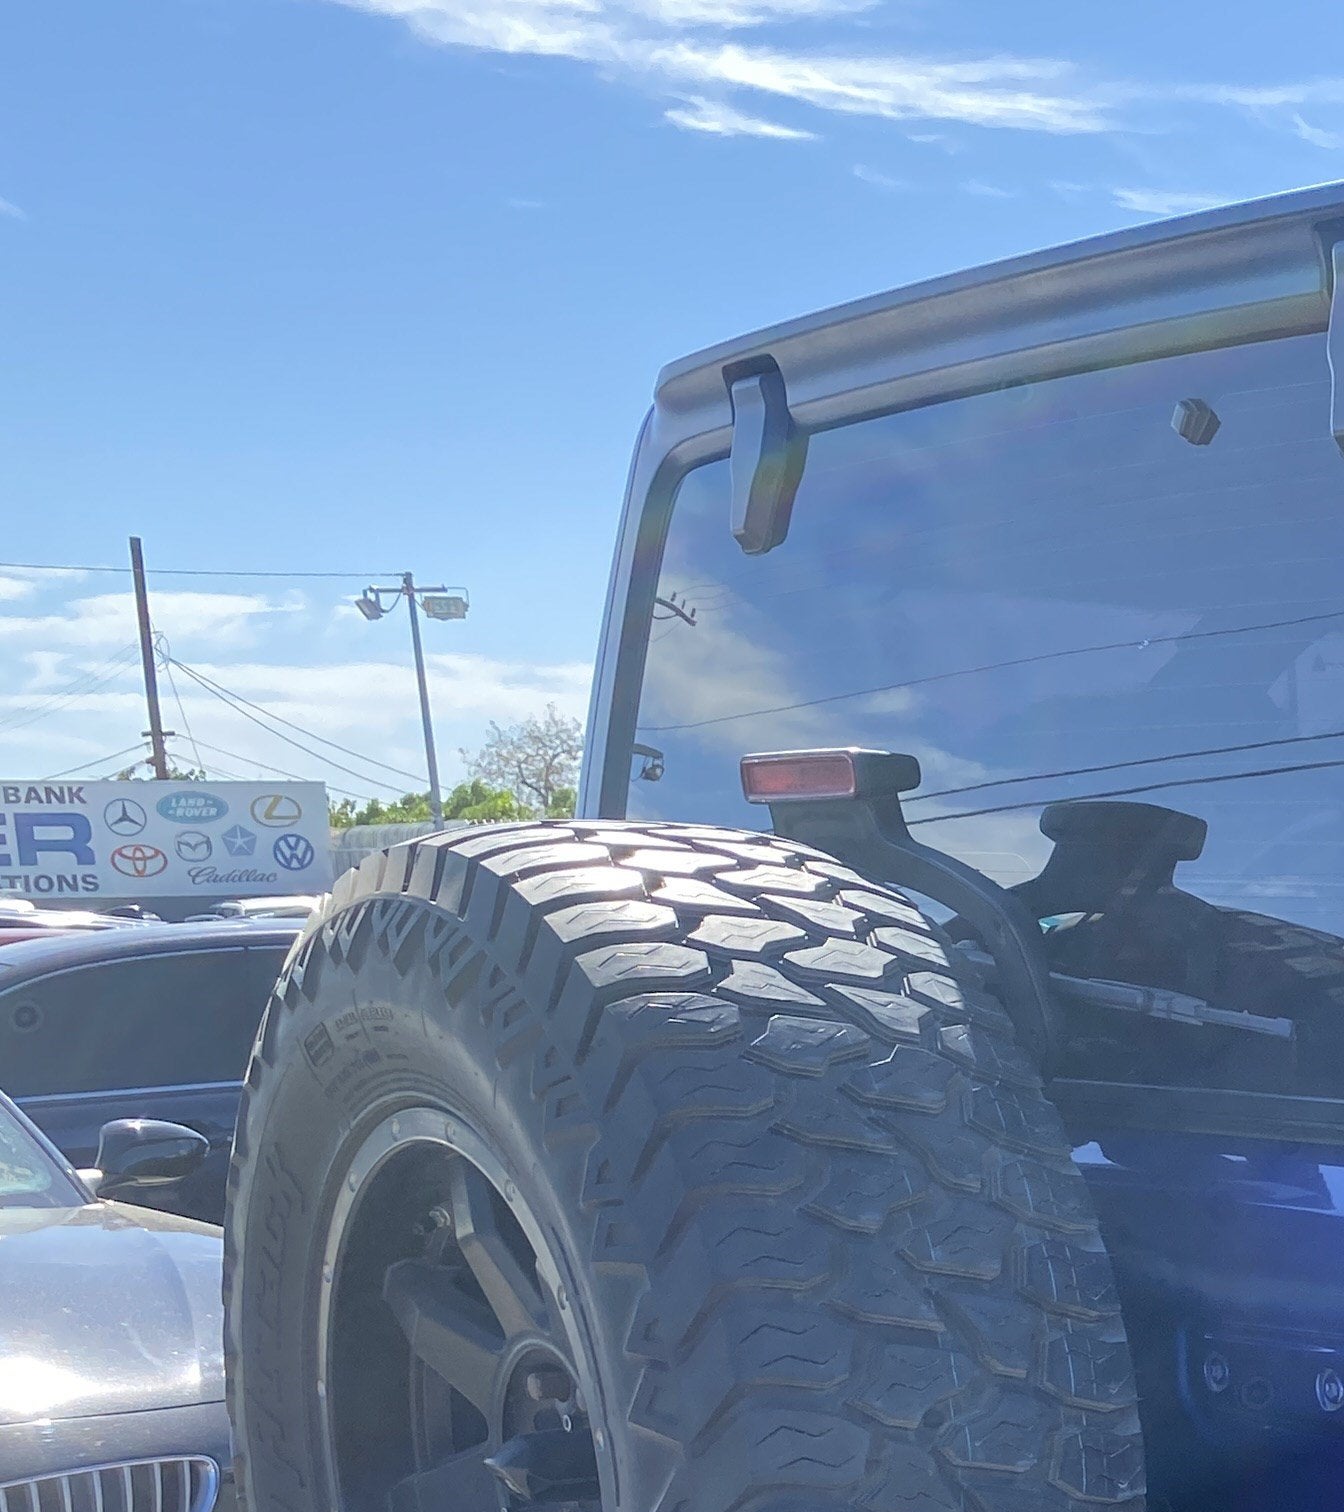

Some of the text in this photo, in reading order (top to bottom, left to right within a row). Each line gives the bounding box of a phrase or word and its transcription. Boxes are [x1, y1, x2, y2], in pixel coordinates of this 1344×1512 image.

[3, 786, 87, 805] BANK
[0, 812, 96, 867] R
[187, 866, 279, 886] Cadillac
